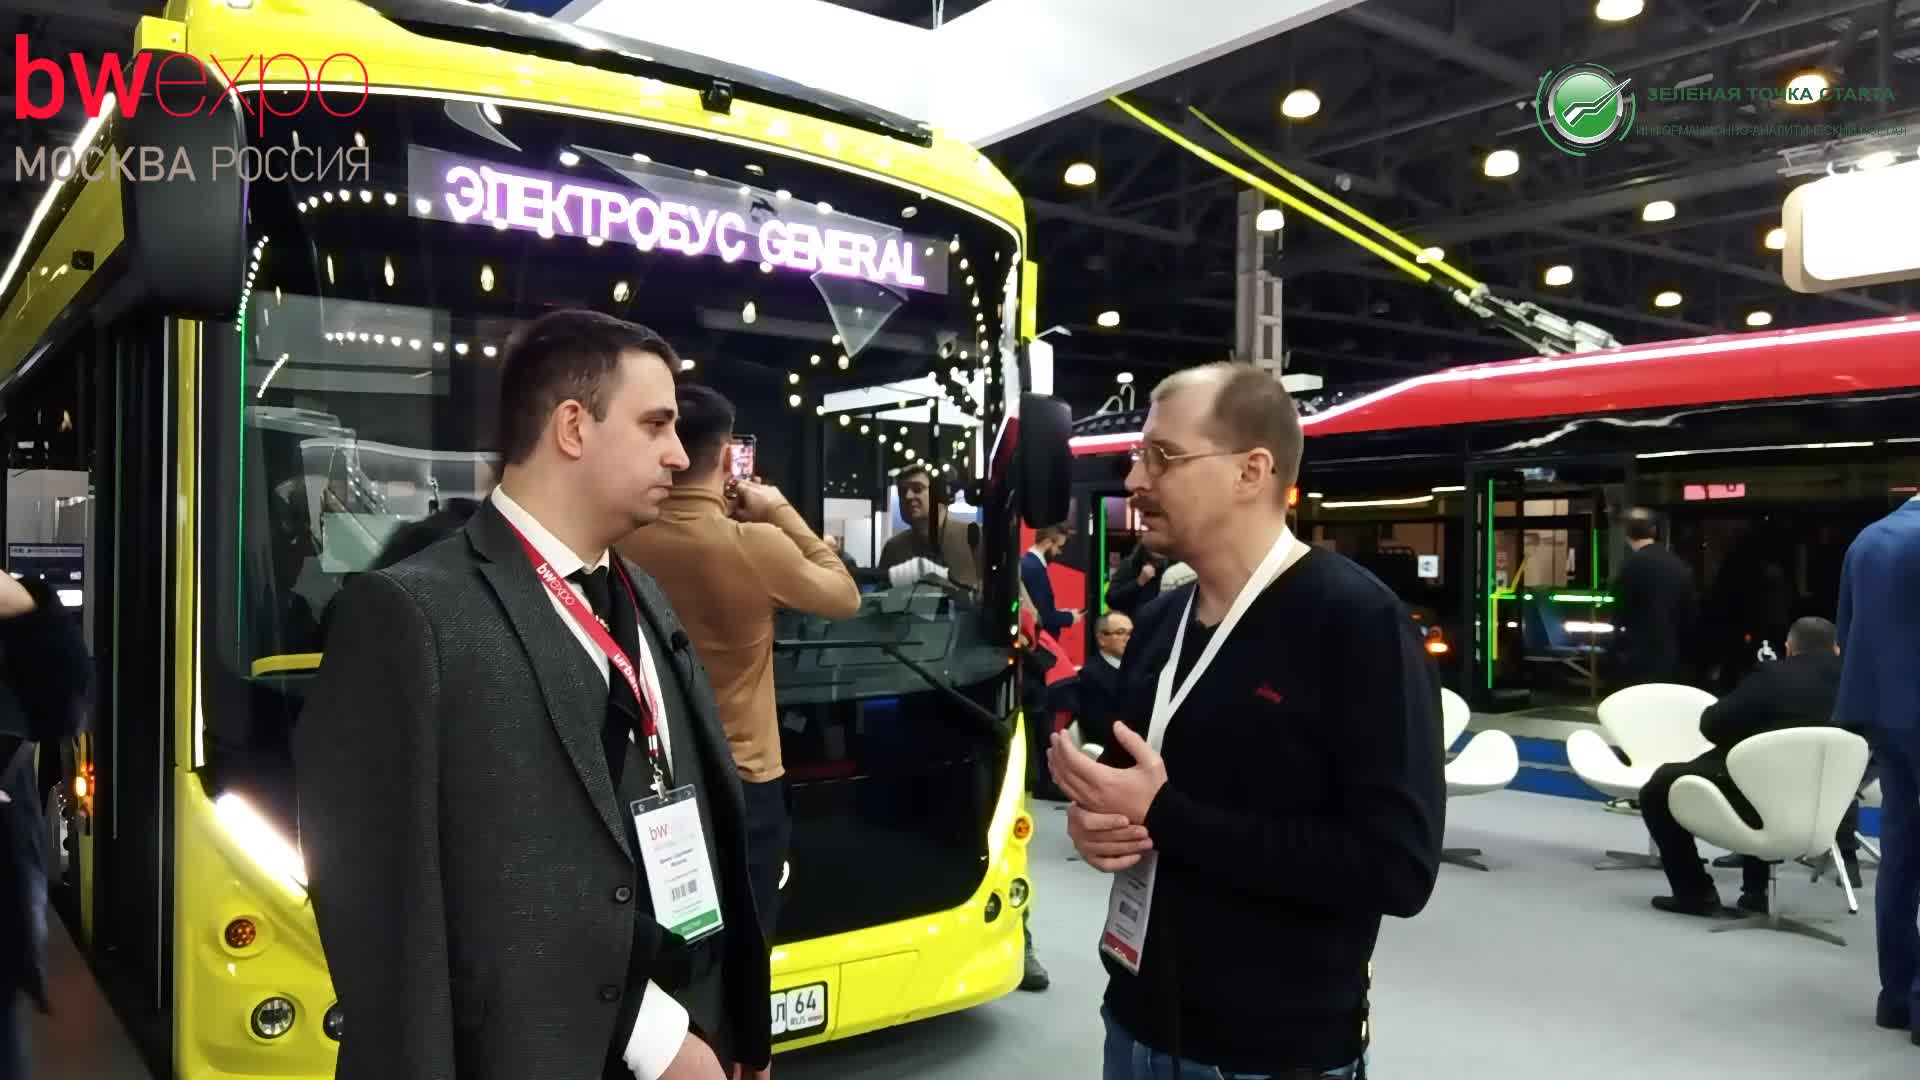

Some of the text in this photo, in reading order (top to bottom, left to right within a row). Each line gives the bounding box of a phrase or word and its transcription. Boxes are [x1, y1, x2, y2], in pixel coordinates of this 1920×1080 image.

[445, 165, 925, 286] ЭЛЕКТРОБУС GENERAL
[771, 990, 816, 1023] Л 64
